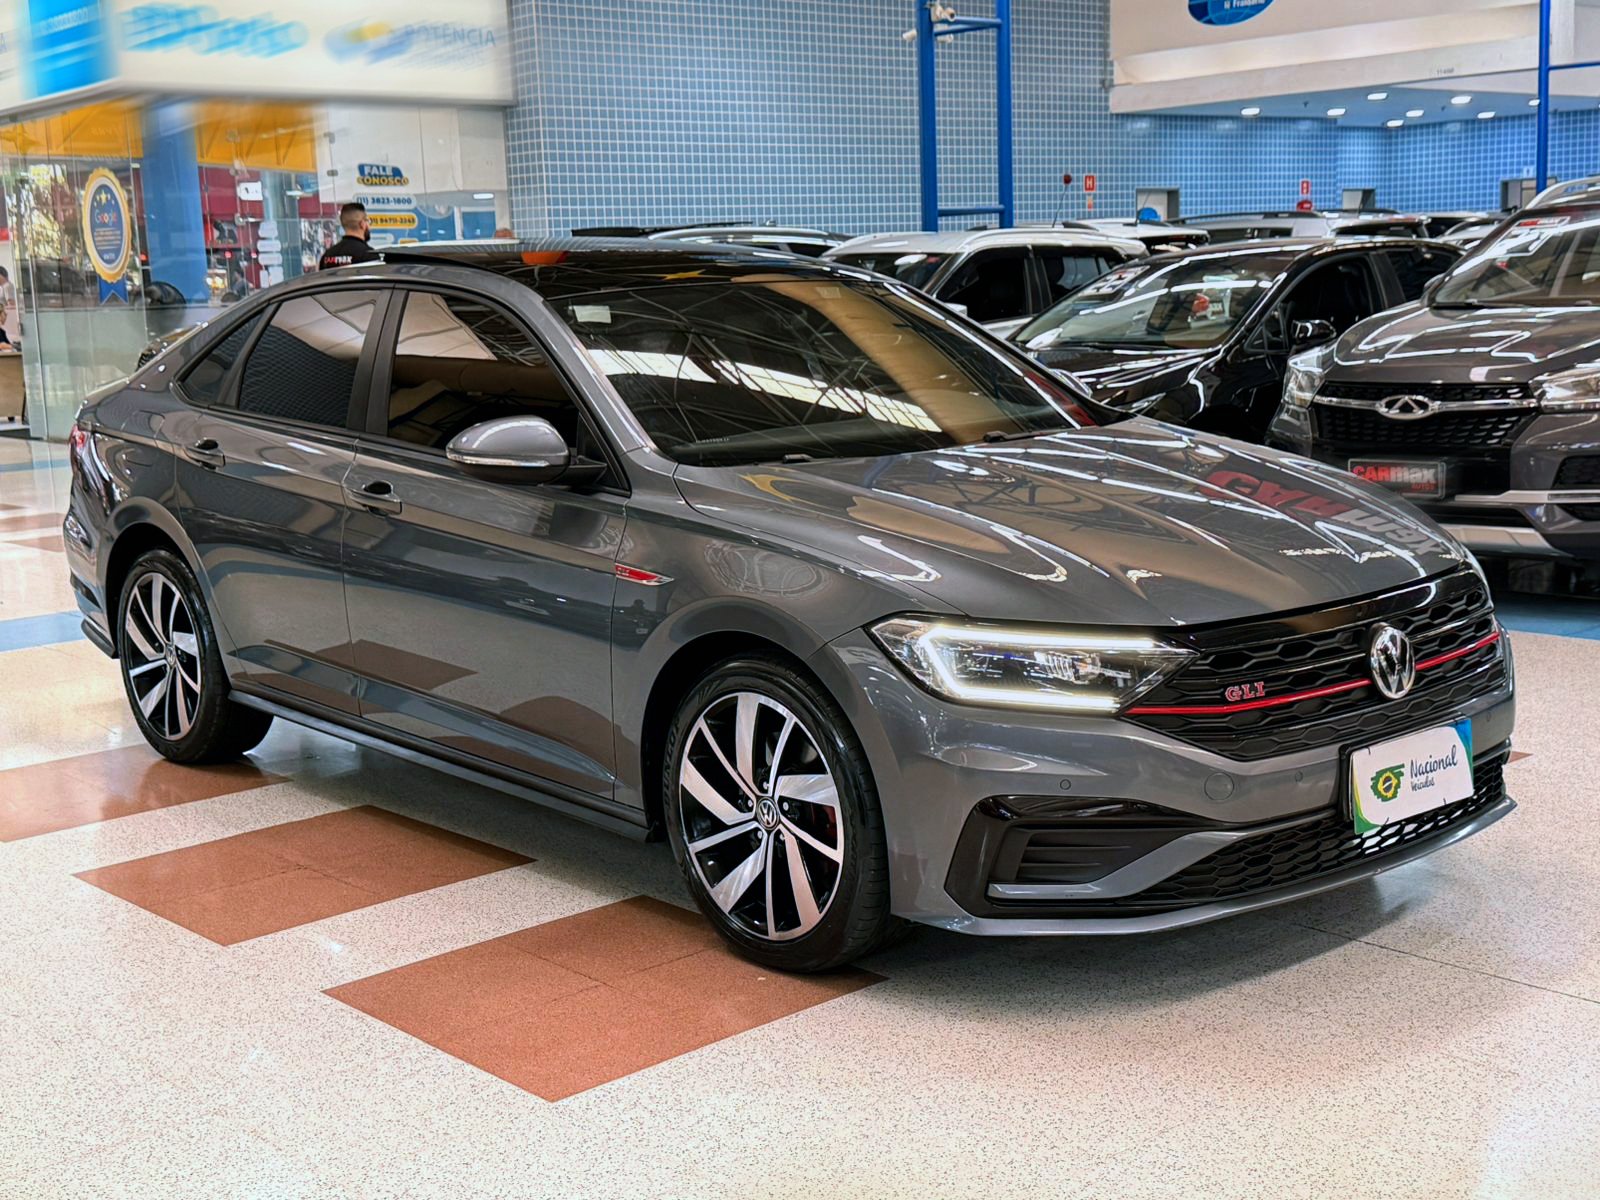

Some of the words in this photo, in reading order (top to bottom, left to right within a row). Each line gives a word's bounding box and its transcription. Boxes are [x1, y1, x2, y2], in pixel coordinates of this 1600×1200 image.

[363, 166, 394, 175] FALE
[357, 175, 409, 186] CONOSCO
[94, 210, 118, 227] Google
[1225, 681, 1265, 701] GLI
[1410, 744, 1458, 779] Nacional
